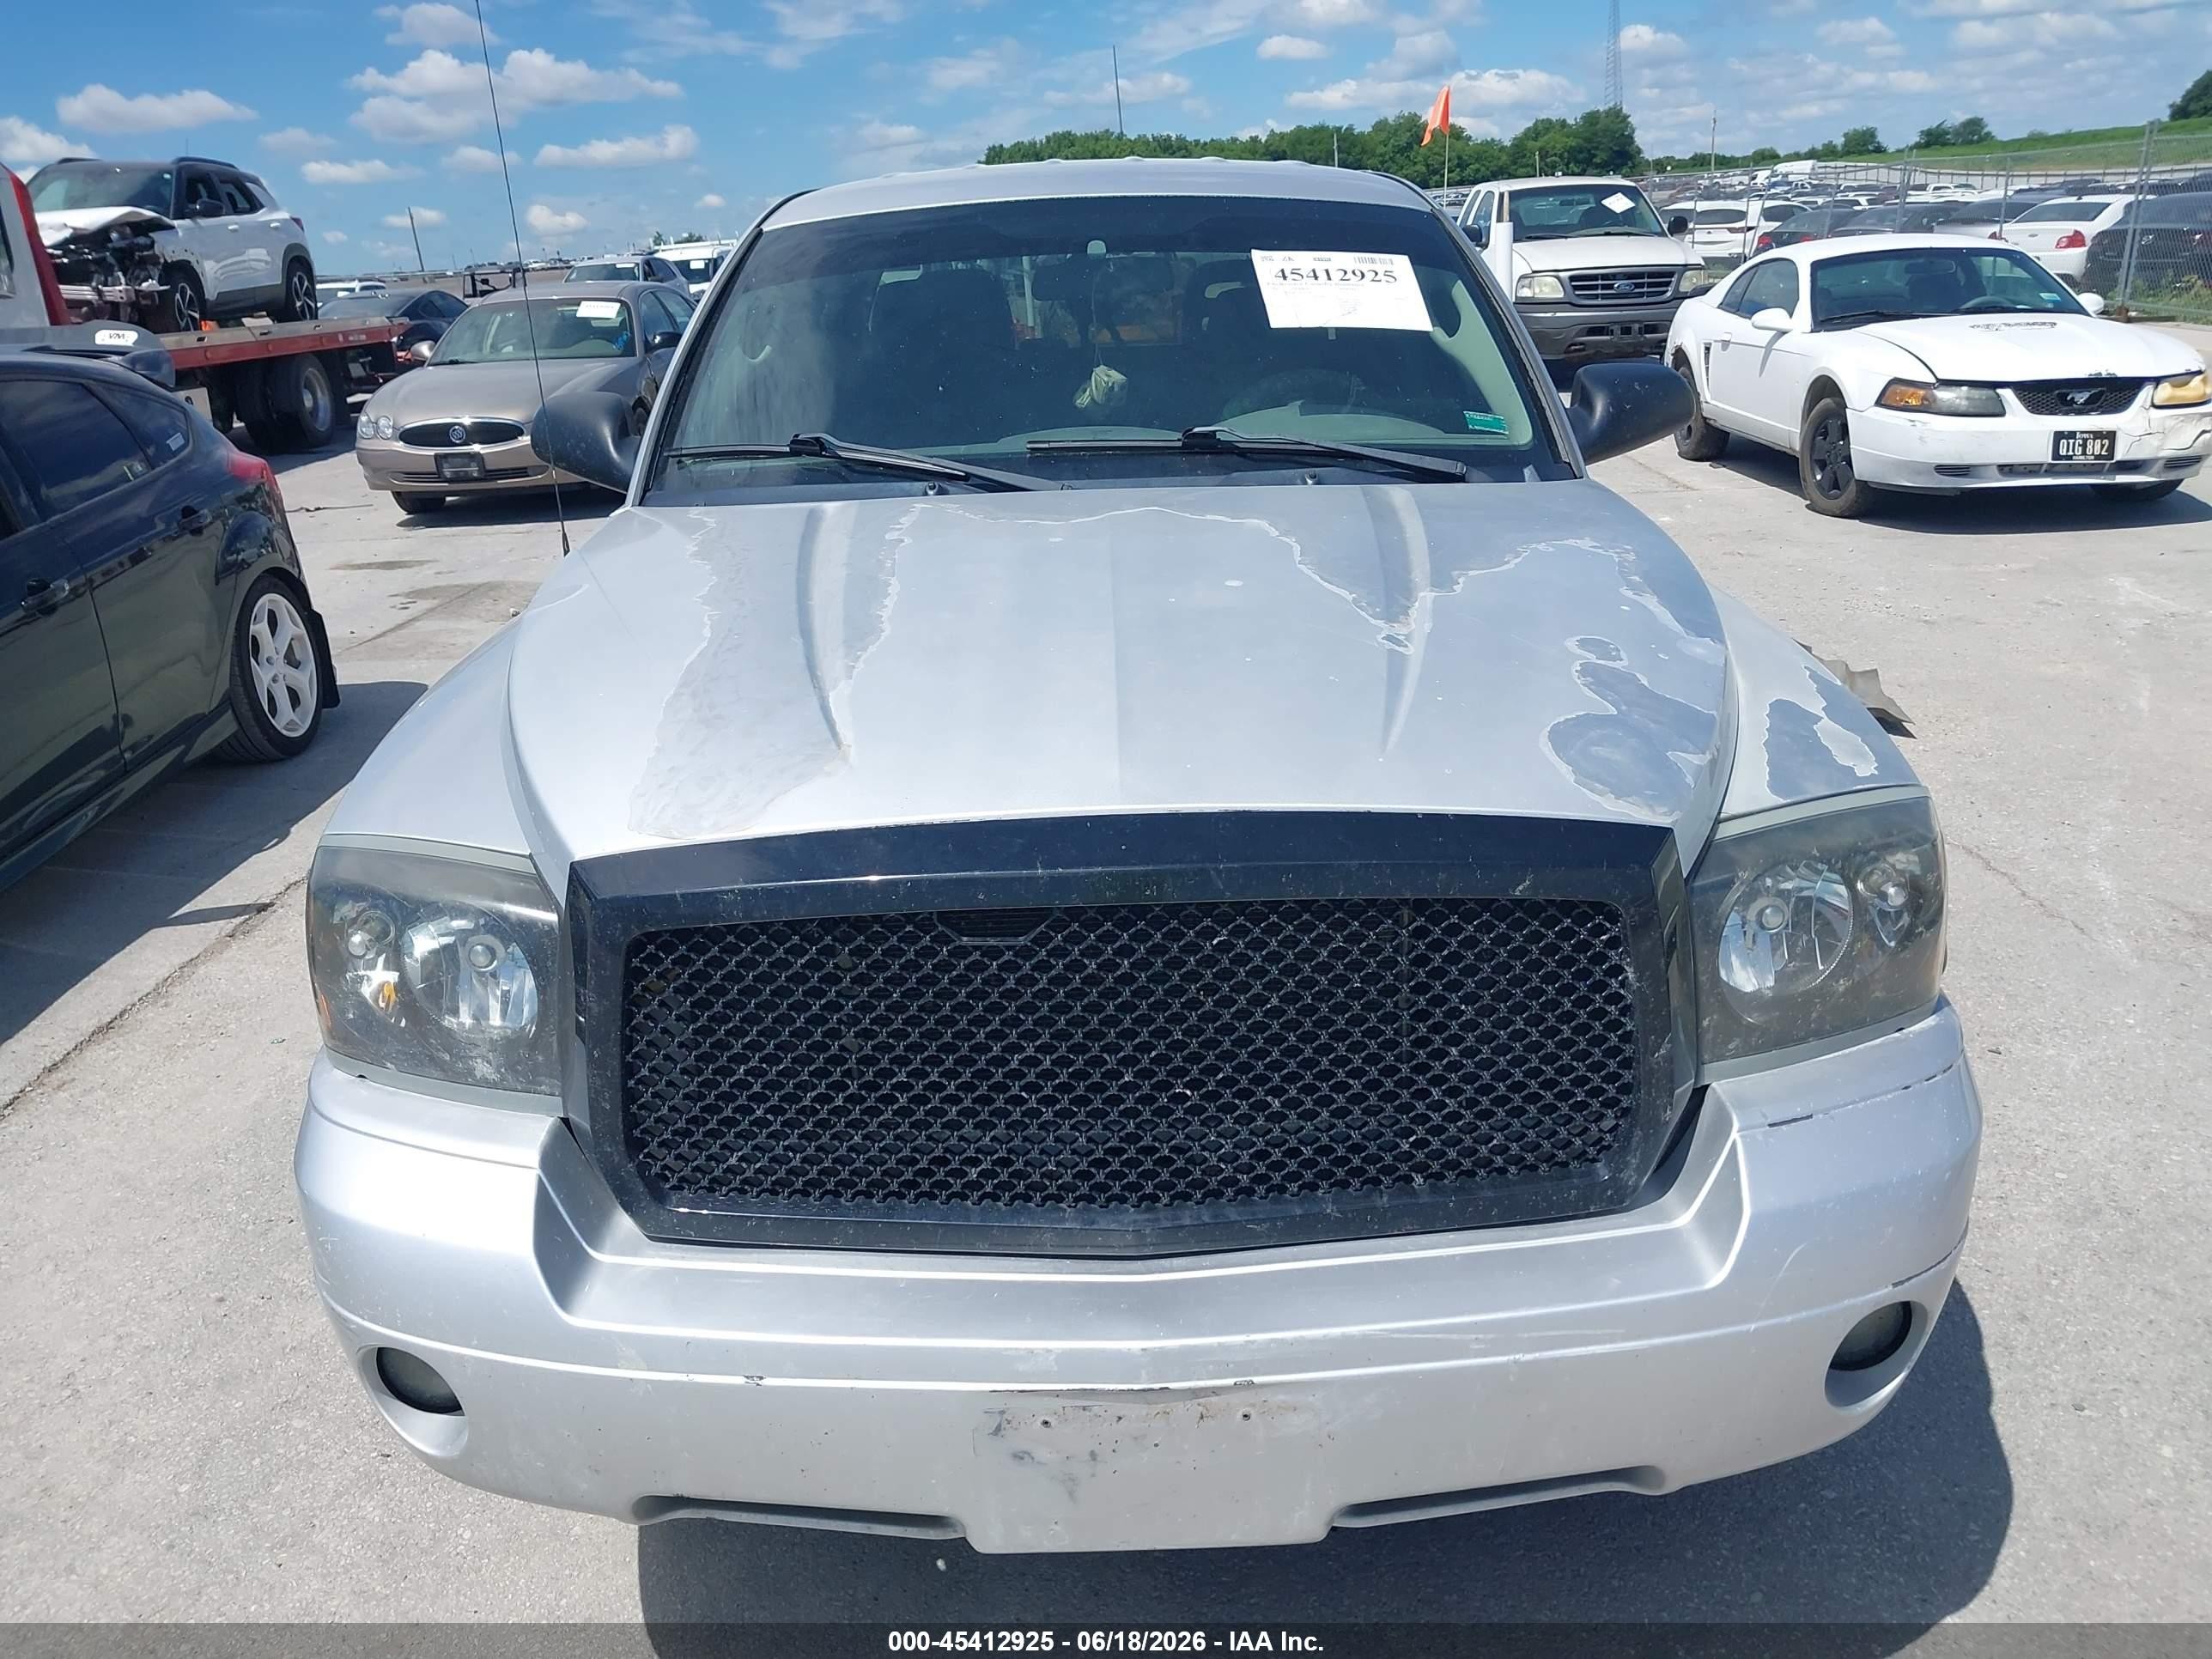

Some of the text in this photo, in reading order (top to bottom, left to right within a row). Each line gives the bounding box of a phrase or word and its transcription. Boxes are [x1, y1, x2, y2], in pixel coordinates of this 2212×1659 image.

[1274, 268, 1397, 283] 45412925
[2059, 440, 2109, 455] QIG 802
